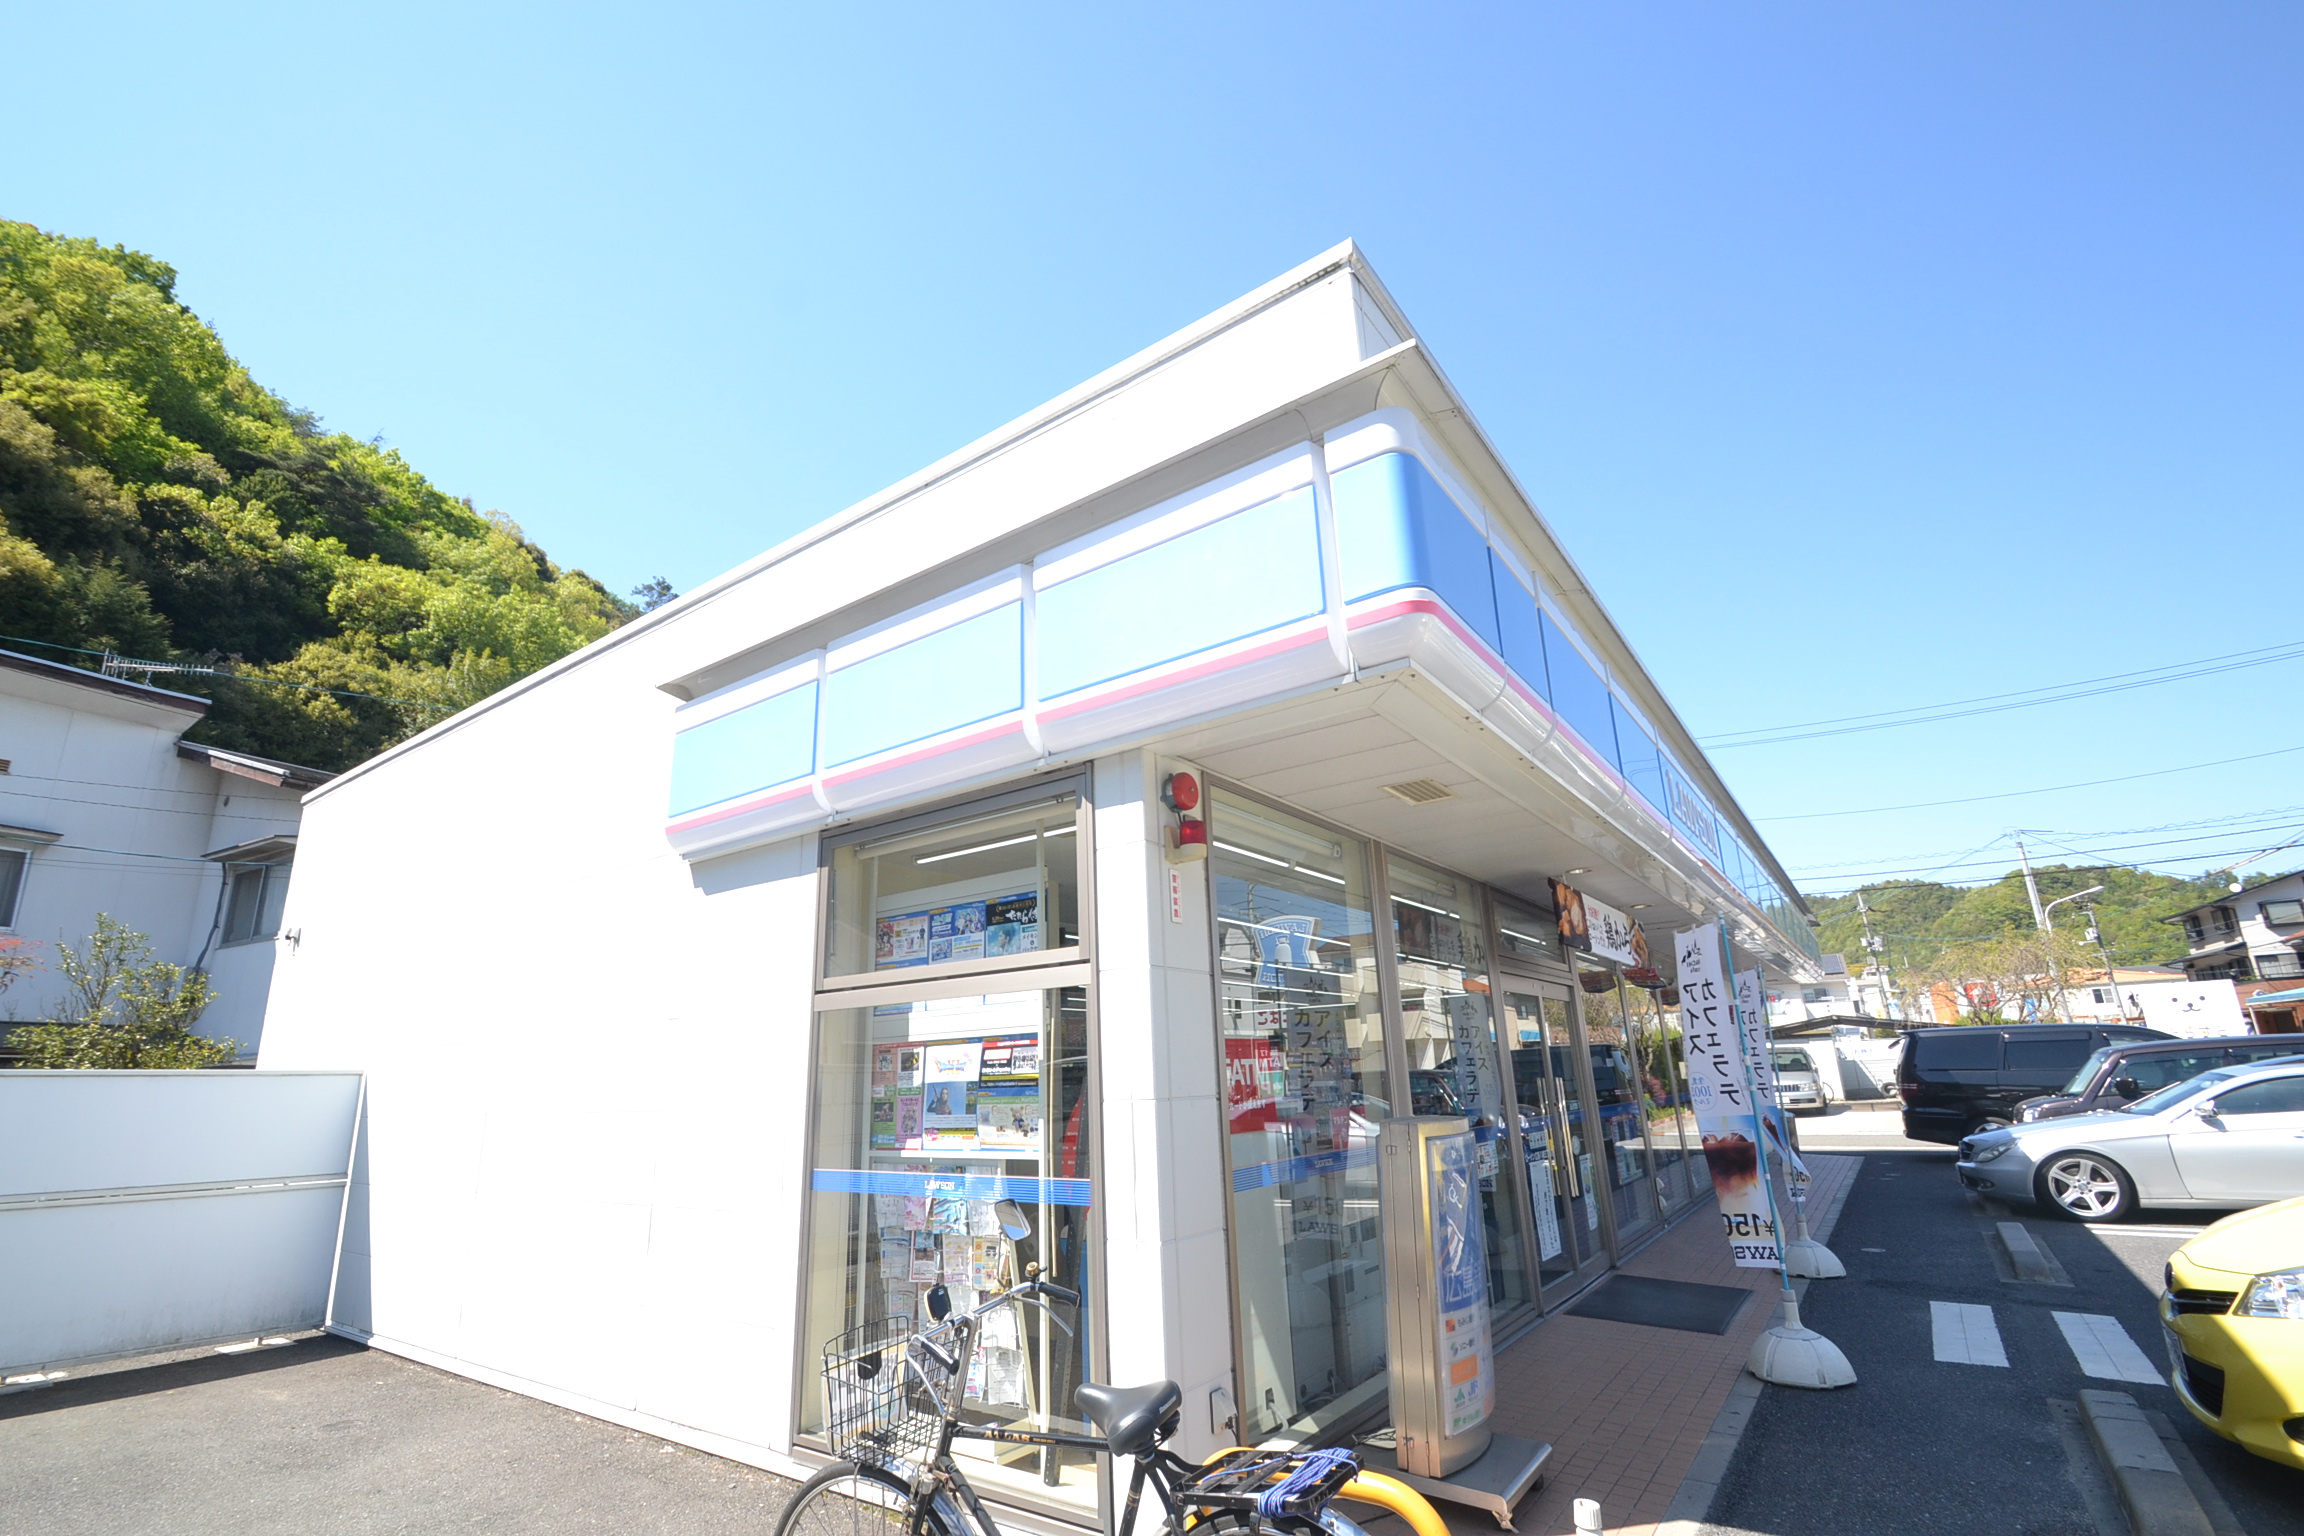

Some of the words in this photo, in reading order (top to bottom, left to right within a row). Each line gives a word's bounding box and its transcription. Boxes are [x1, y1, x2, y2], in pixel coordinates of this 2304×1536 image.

[1666, 769, 1719, 859] LAWSON
[1314, 1010, 1333, 1068] アイス
[1458, 1025, 1480, 1103] カフェラテ
[1471, 1025, 1489, 1070] アイス
[984, 1430, 1031, 1443] ATLAS
